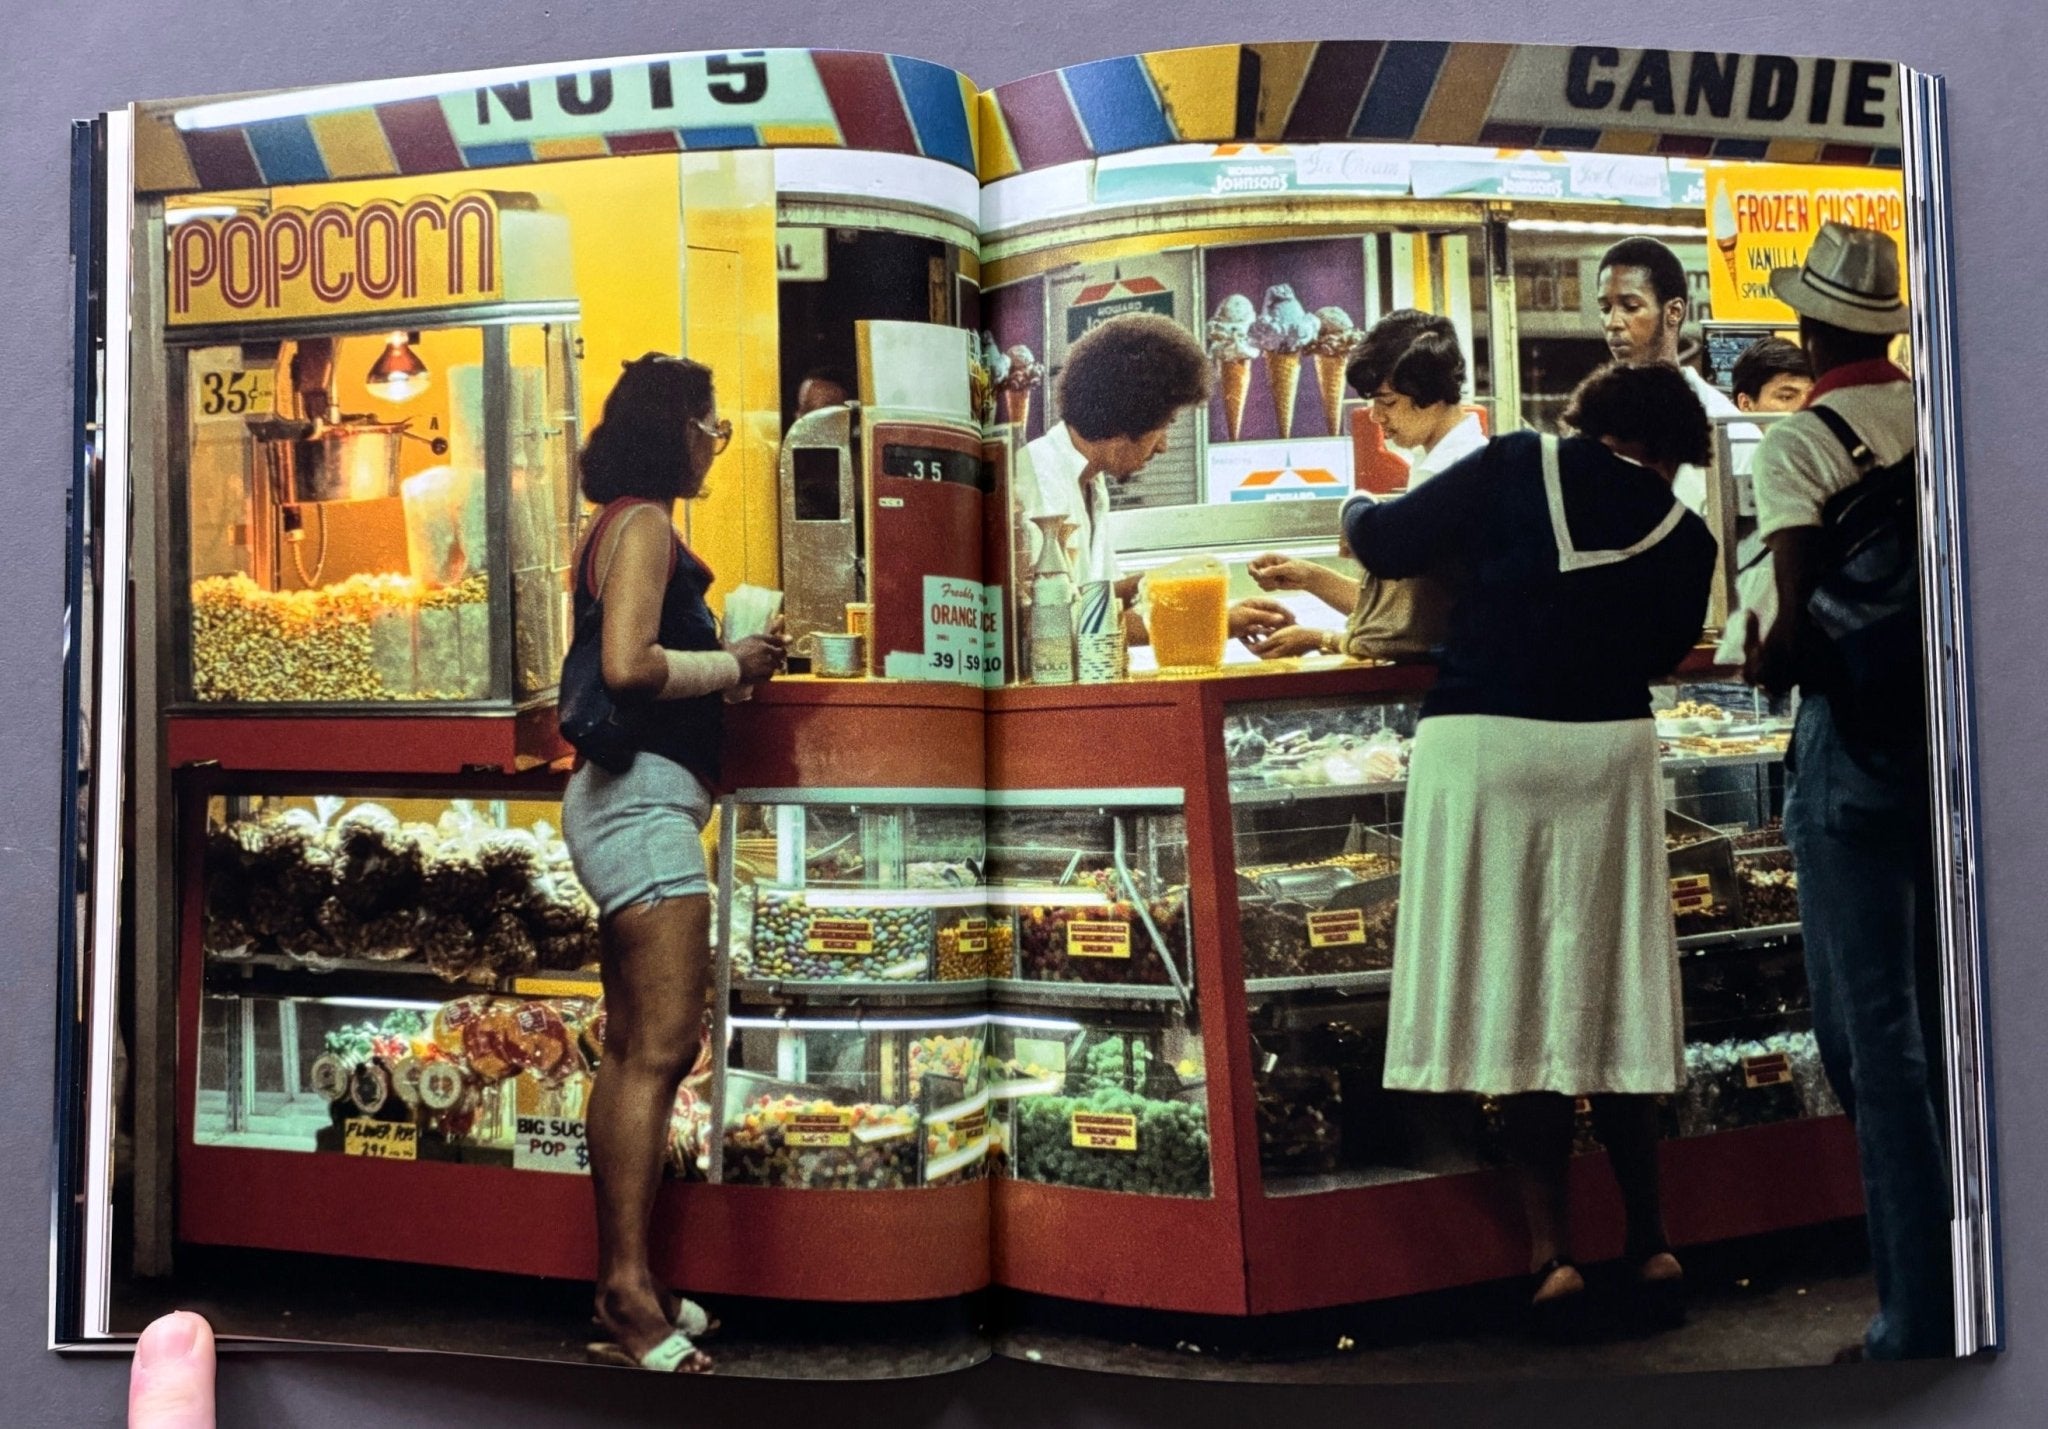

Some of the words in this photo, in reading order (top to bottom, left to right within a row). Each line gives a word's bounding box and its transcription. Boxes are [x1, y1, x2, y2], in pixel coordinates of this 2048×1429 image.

[1565, 46, 1901, 128] CANDIE
[1736, 193, 1810, 232] FROZEN
[1816, 191, 1901, 230] CUSTARD
[1747, 247, 1799, 270] VANILLA
[1741, 282, 1776, 299] SPRINK
[931, 603, 977, 629] ORANGE
[518, 1117, 545, 1136] BIG
[550, 1120, 584, 1139] SUC
[530, 1139, 566, 1157] POP
